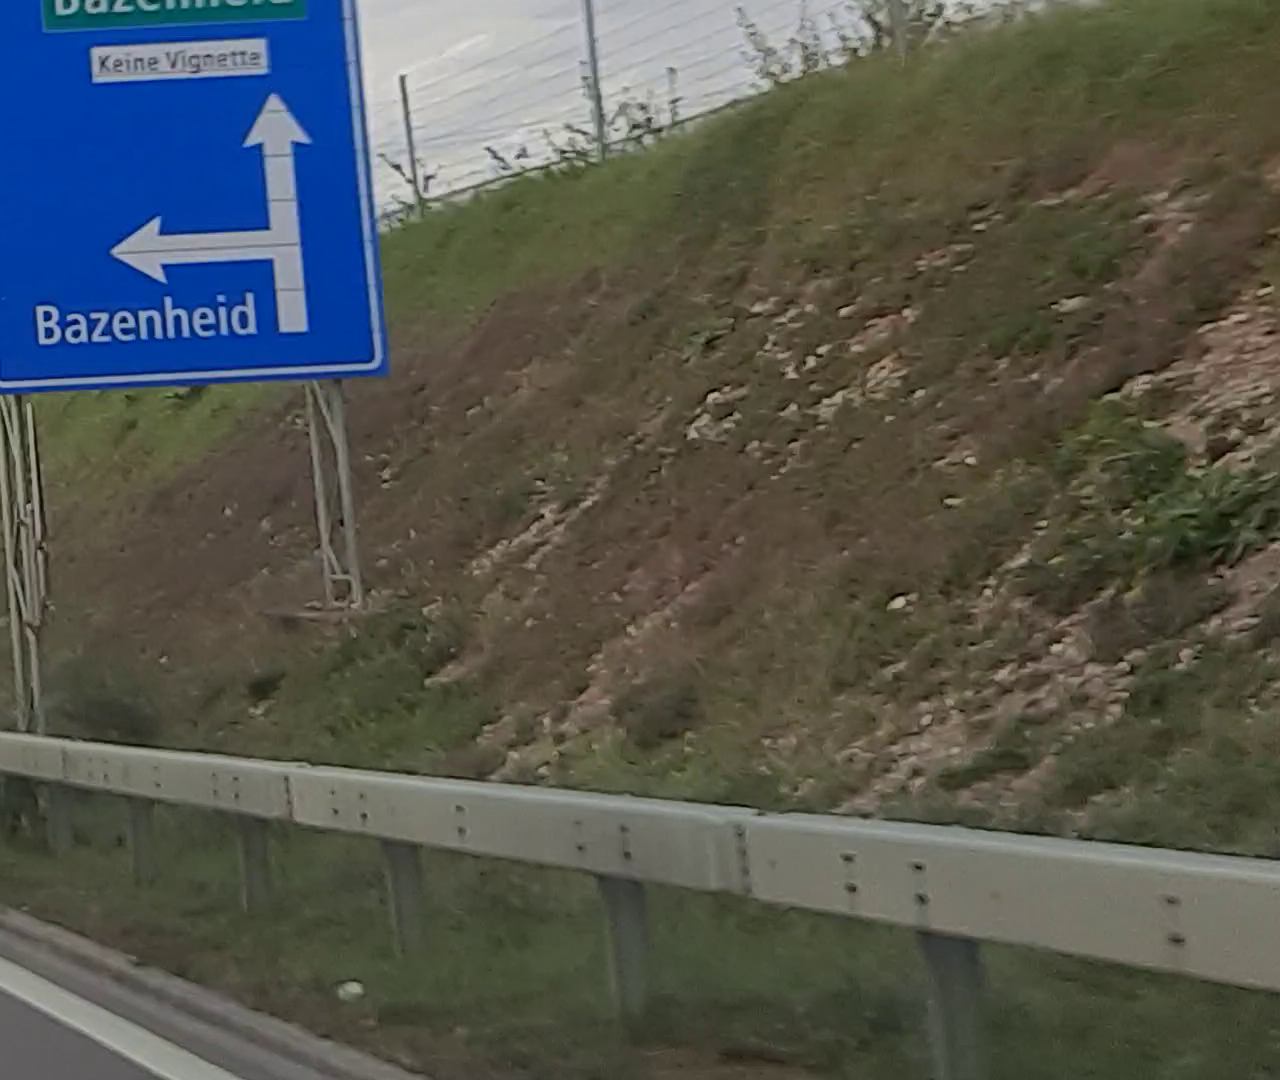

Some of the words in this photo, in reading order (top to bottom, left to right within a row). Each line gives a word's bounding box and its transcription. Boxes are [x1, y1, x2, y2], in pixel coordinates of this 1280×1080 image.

[97, 53, 159, 74] Keine
[165, 49, 262, 74] Vignette
[35, 292, 258, 346] Bazenheid
